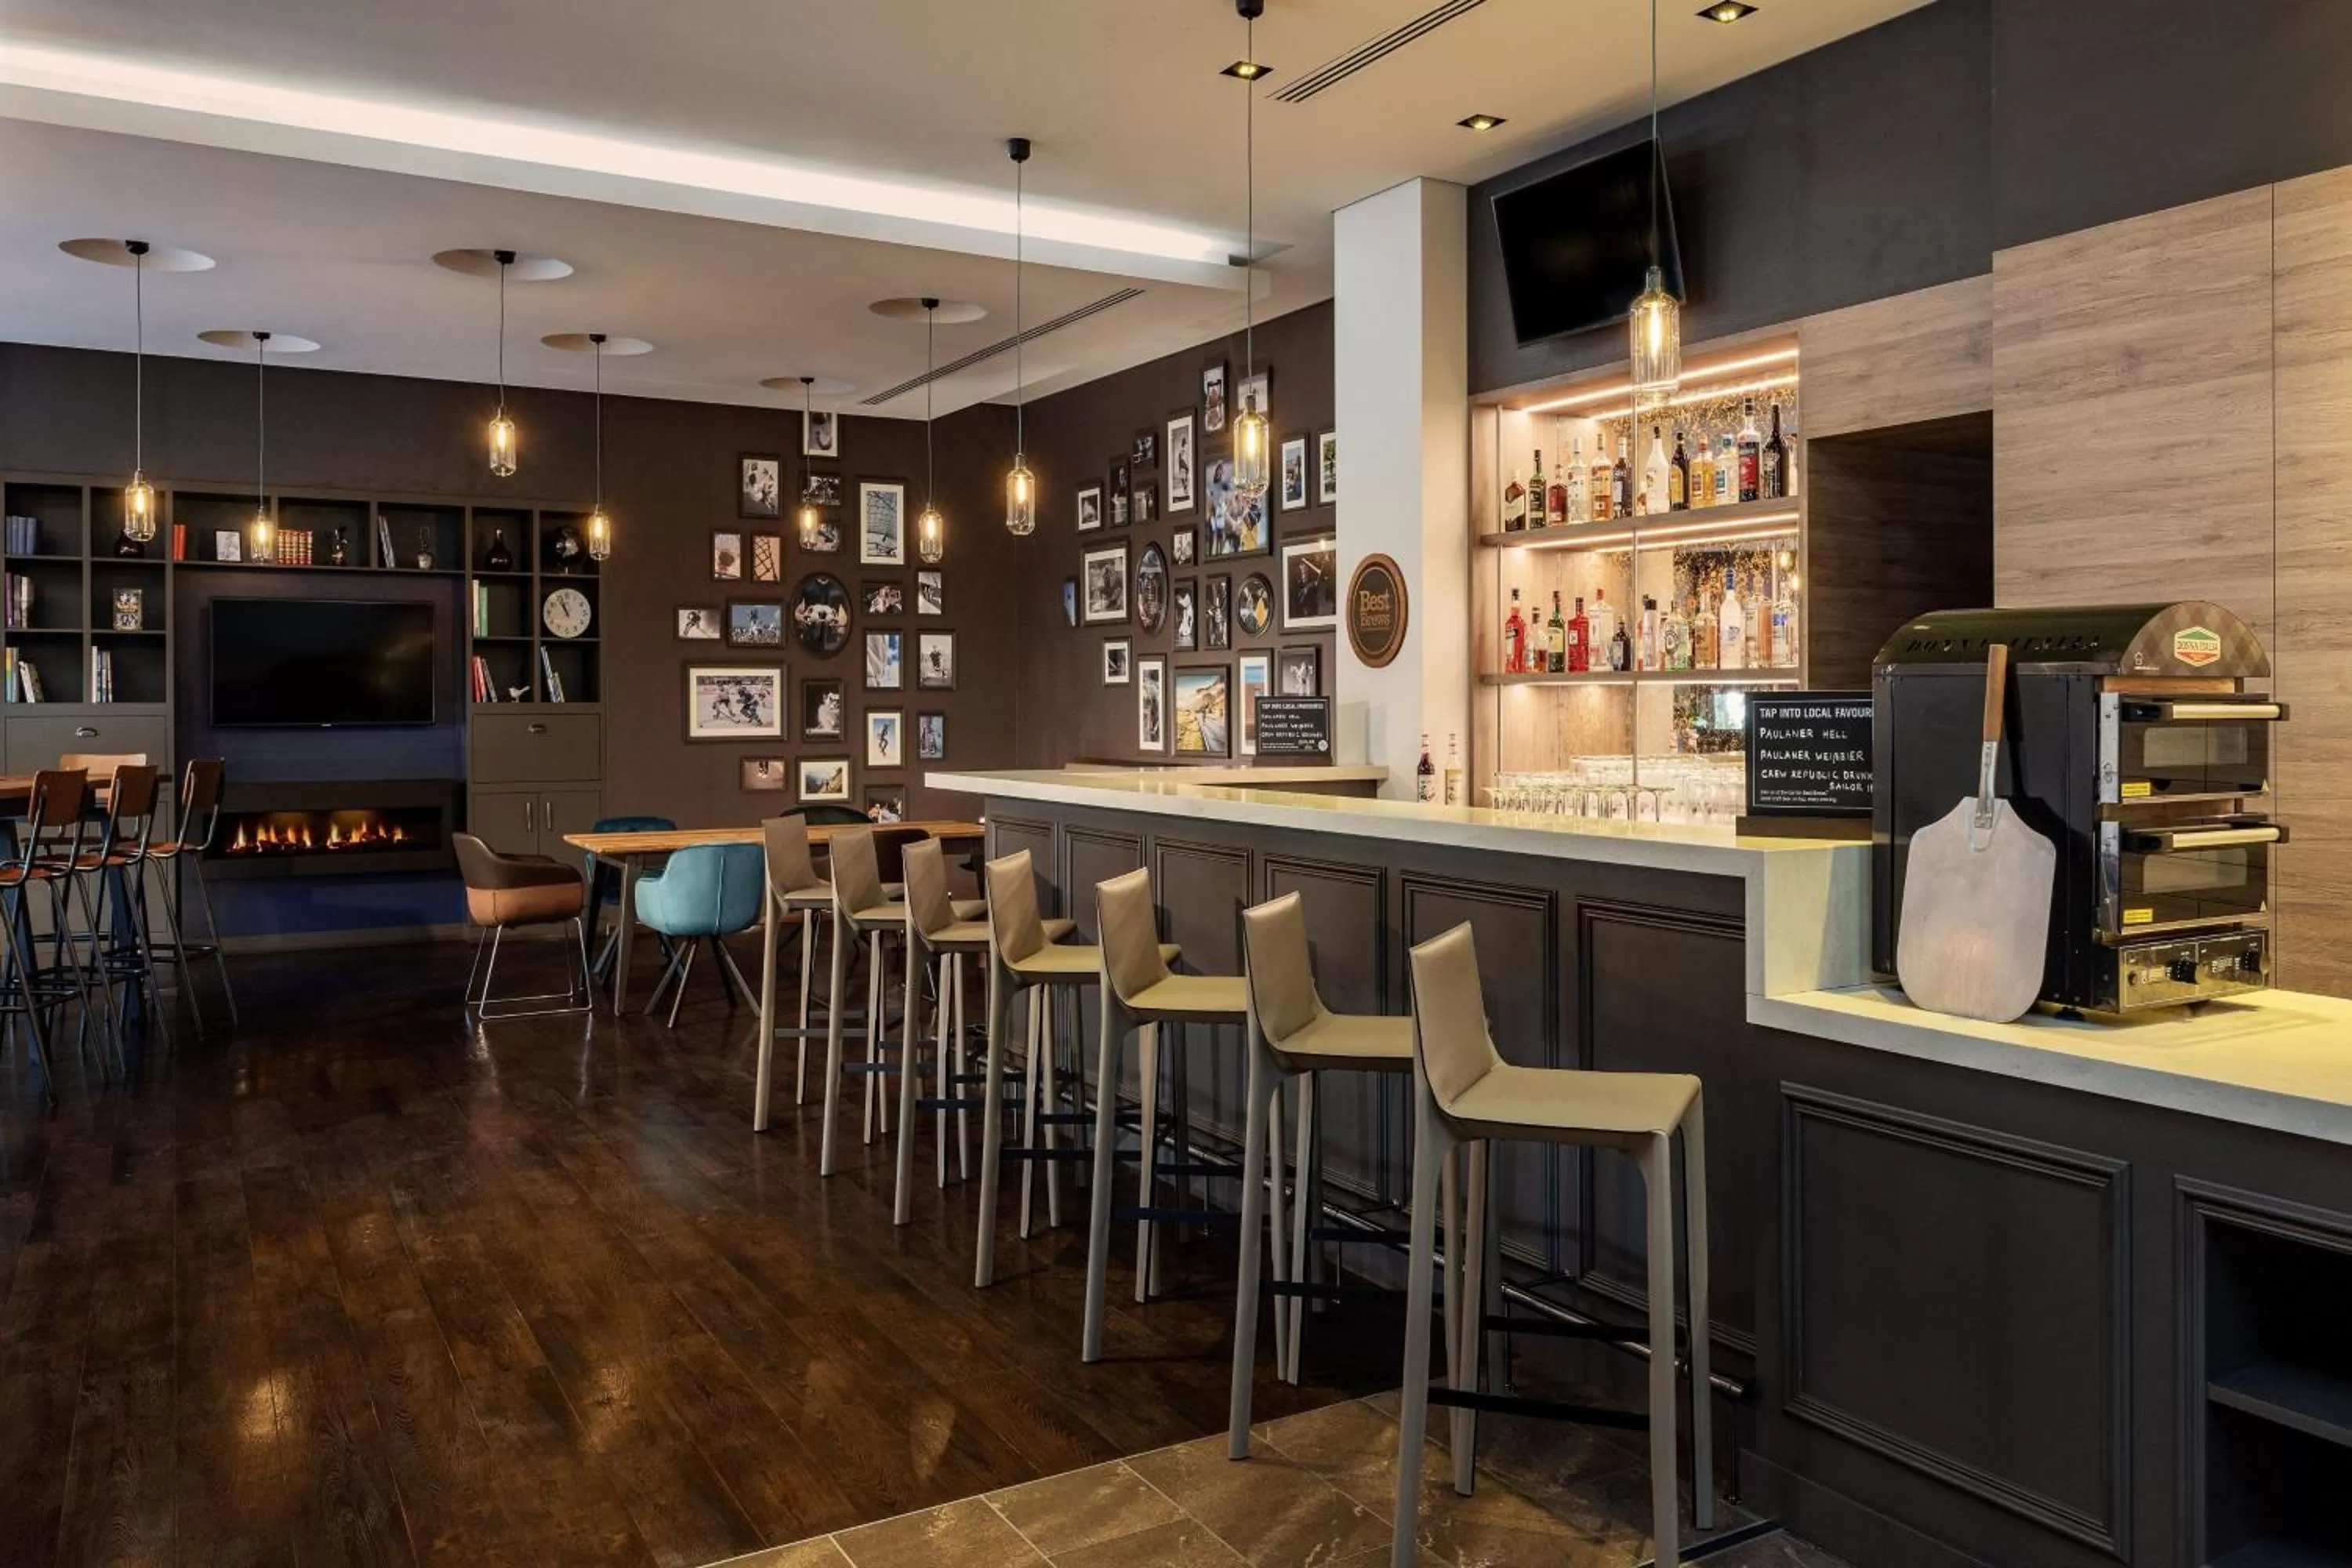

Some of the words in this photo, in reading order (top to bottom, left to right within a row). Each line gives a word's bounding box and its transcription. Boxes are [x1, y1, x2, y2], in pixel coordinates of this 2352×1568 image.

[1759, 708, 1777, 718] TAP
[1779, 708, 1801, 718] INTO
[1803, 707, 1832, 718] LOCAL
[1759, 728, 1814, 739] PAULANER
[1822, 729, 1848, 739] HELL
[1760, 750, 1810, 760] PAULANER
[1761, 769, 1788, 779] CREW
[1791, 770, 1838, 780] REPUBLIC
[1829, 782, 1863, 791] SAILOR
